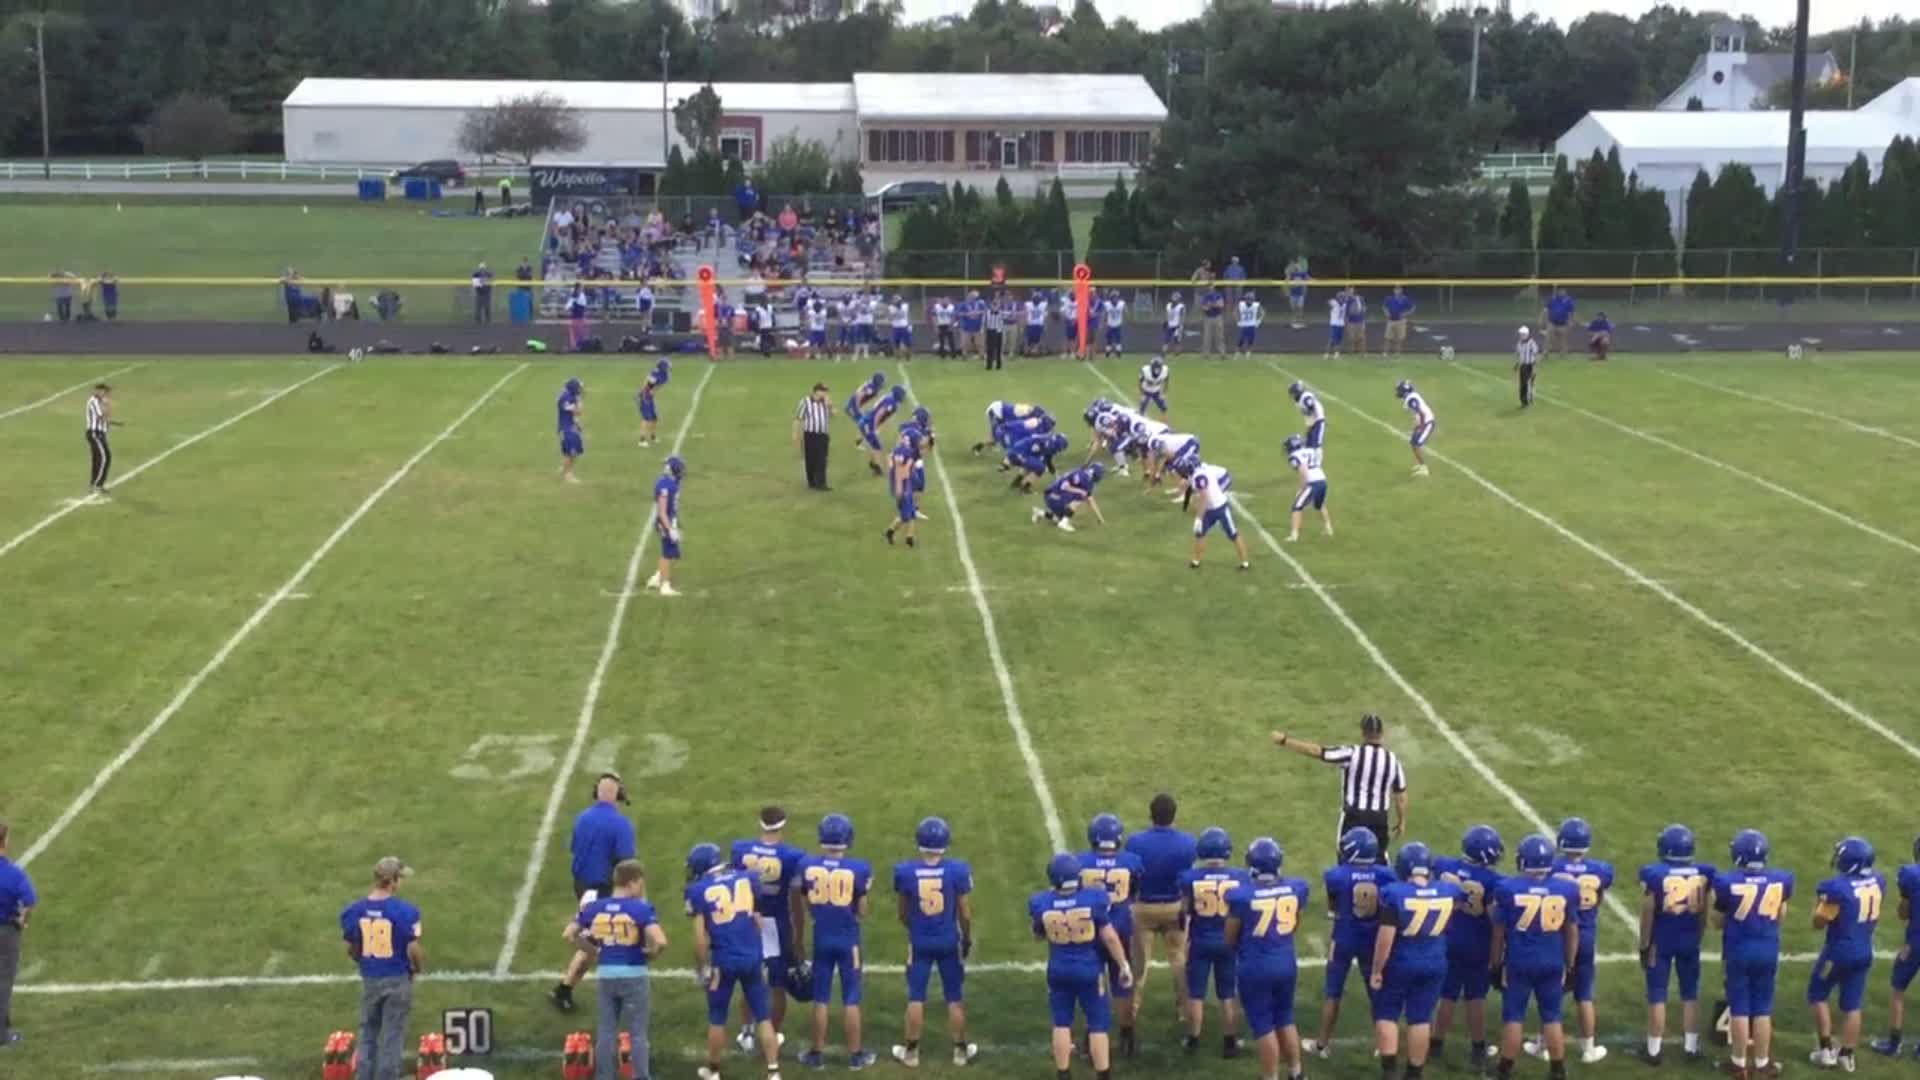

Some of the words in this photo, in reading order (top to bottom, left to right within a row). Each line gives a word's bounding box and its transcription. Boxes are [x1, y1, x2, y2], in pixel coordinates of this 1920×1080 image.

[448, 732, 690, 781] 50
[704, 878, 754, 925] 34
[805, 866, 855, 906] 30
[918, 877, 945, 915] 5
[1730, 882, 1783, 921] 74
[1250, 894, 1299, 937] 79
[1402, 896, 1454, 937] 77
[444, 1010, 491, 1054] 50
